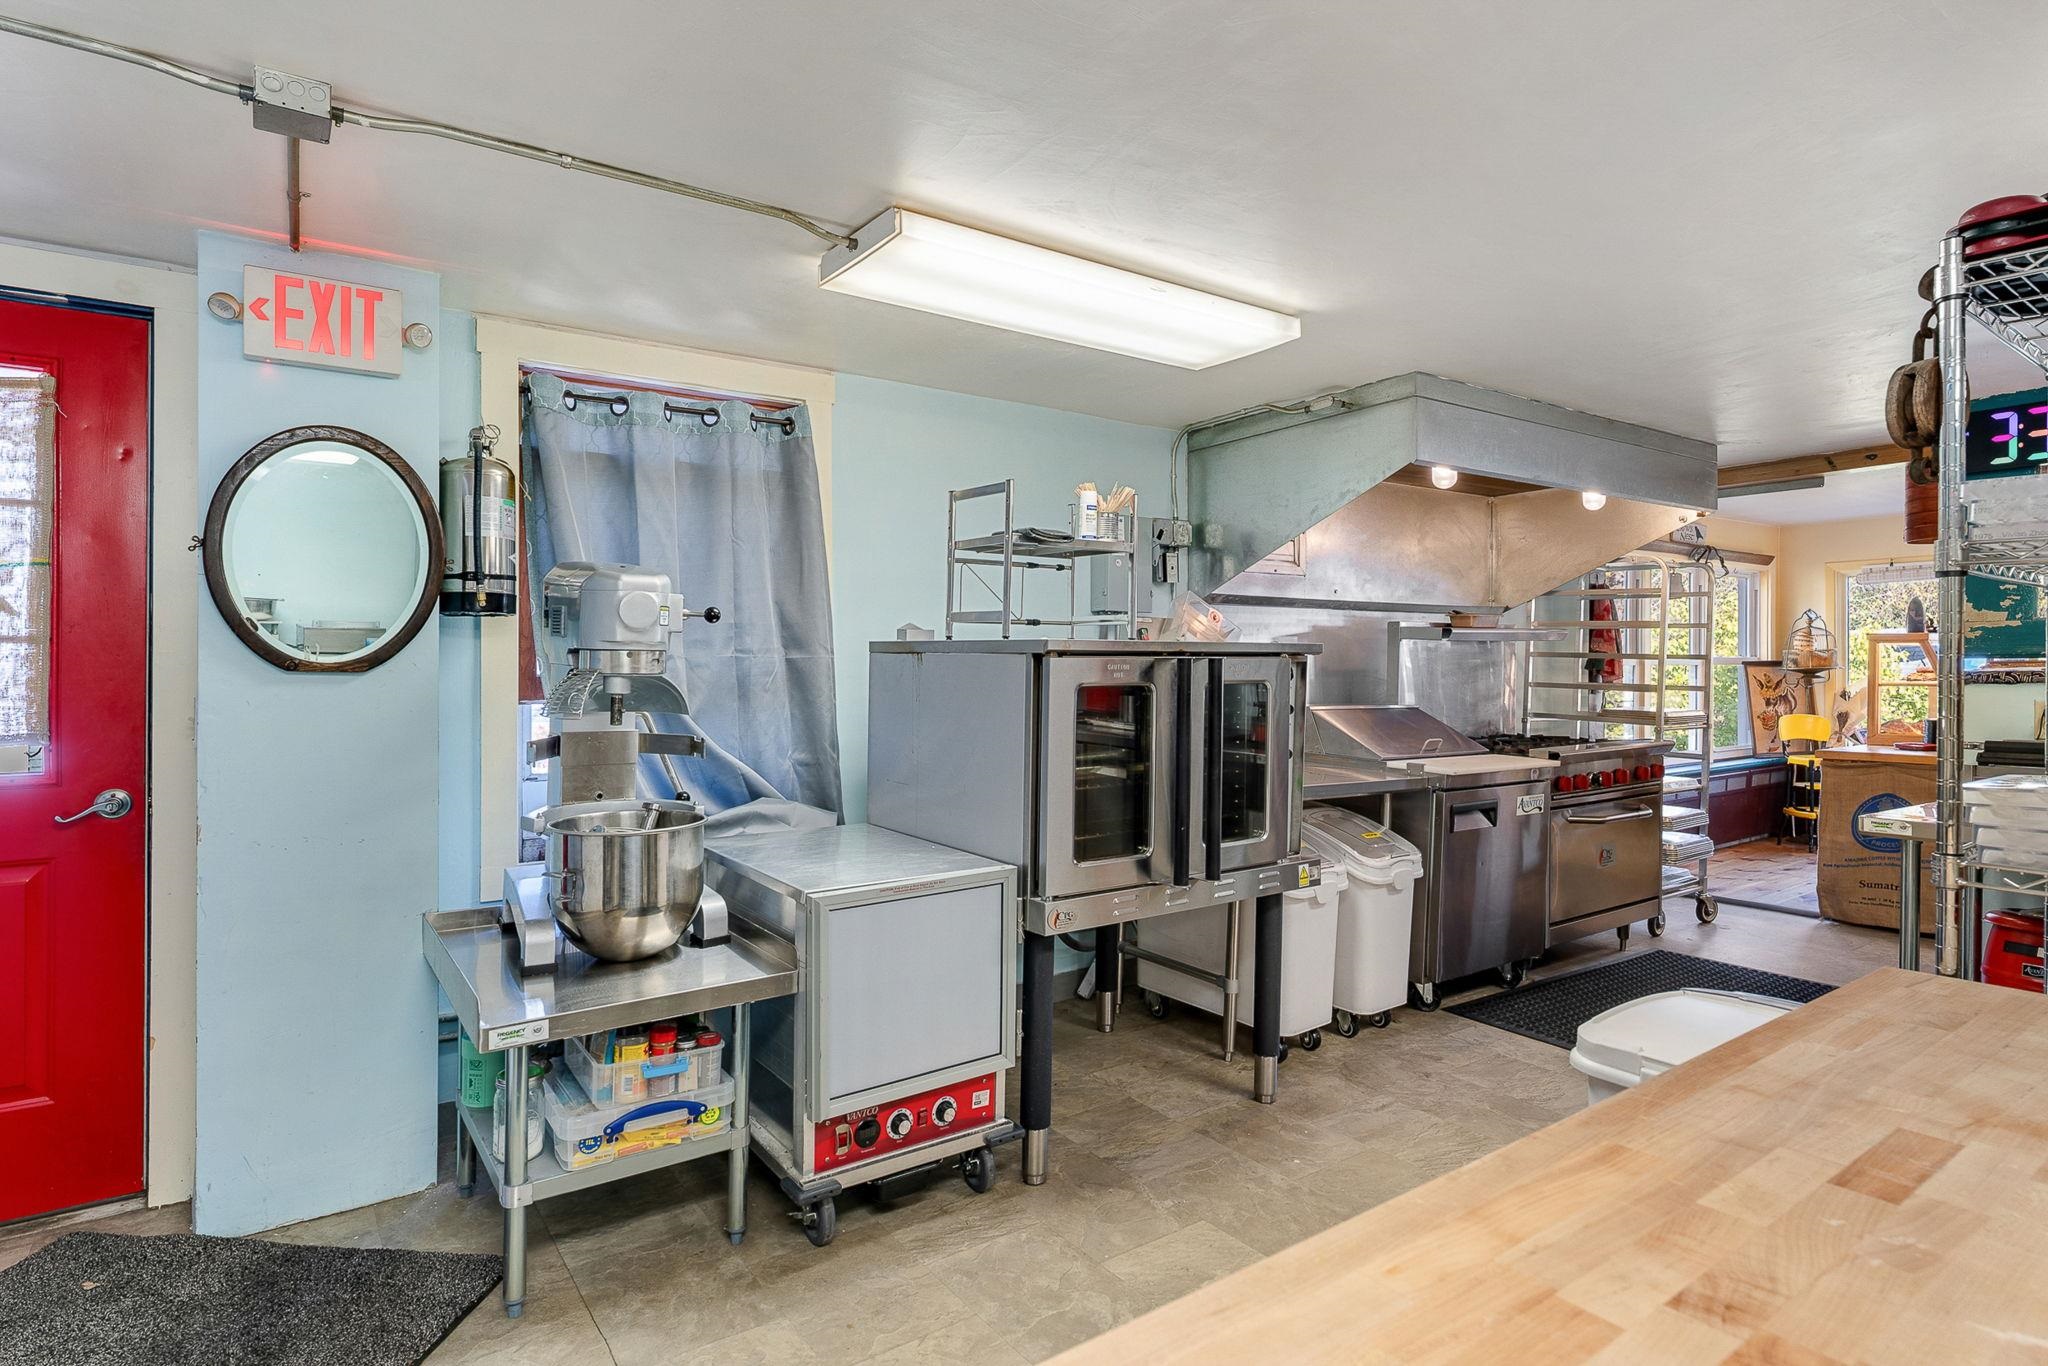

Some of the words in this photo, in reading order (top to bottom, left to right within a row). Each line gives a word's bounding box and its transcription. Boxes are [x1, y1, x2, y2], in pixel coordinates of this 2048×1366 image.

[274, 274, 384, 361] EXIT
[1107, 663, 1130, 671] CAUTION
[1858, 880, 1900, 891] Sumatr
